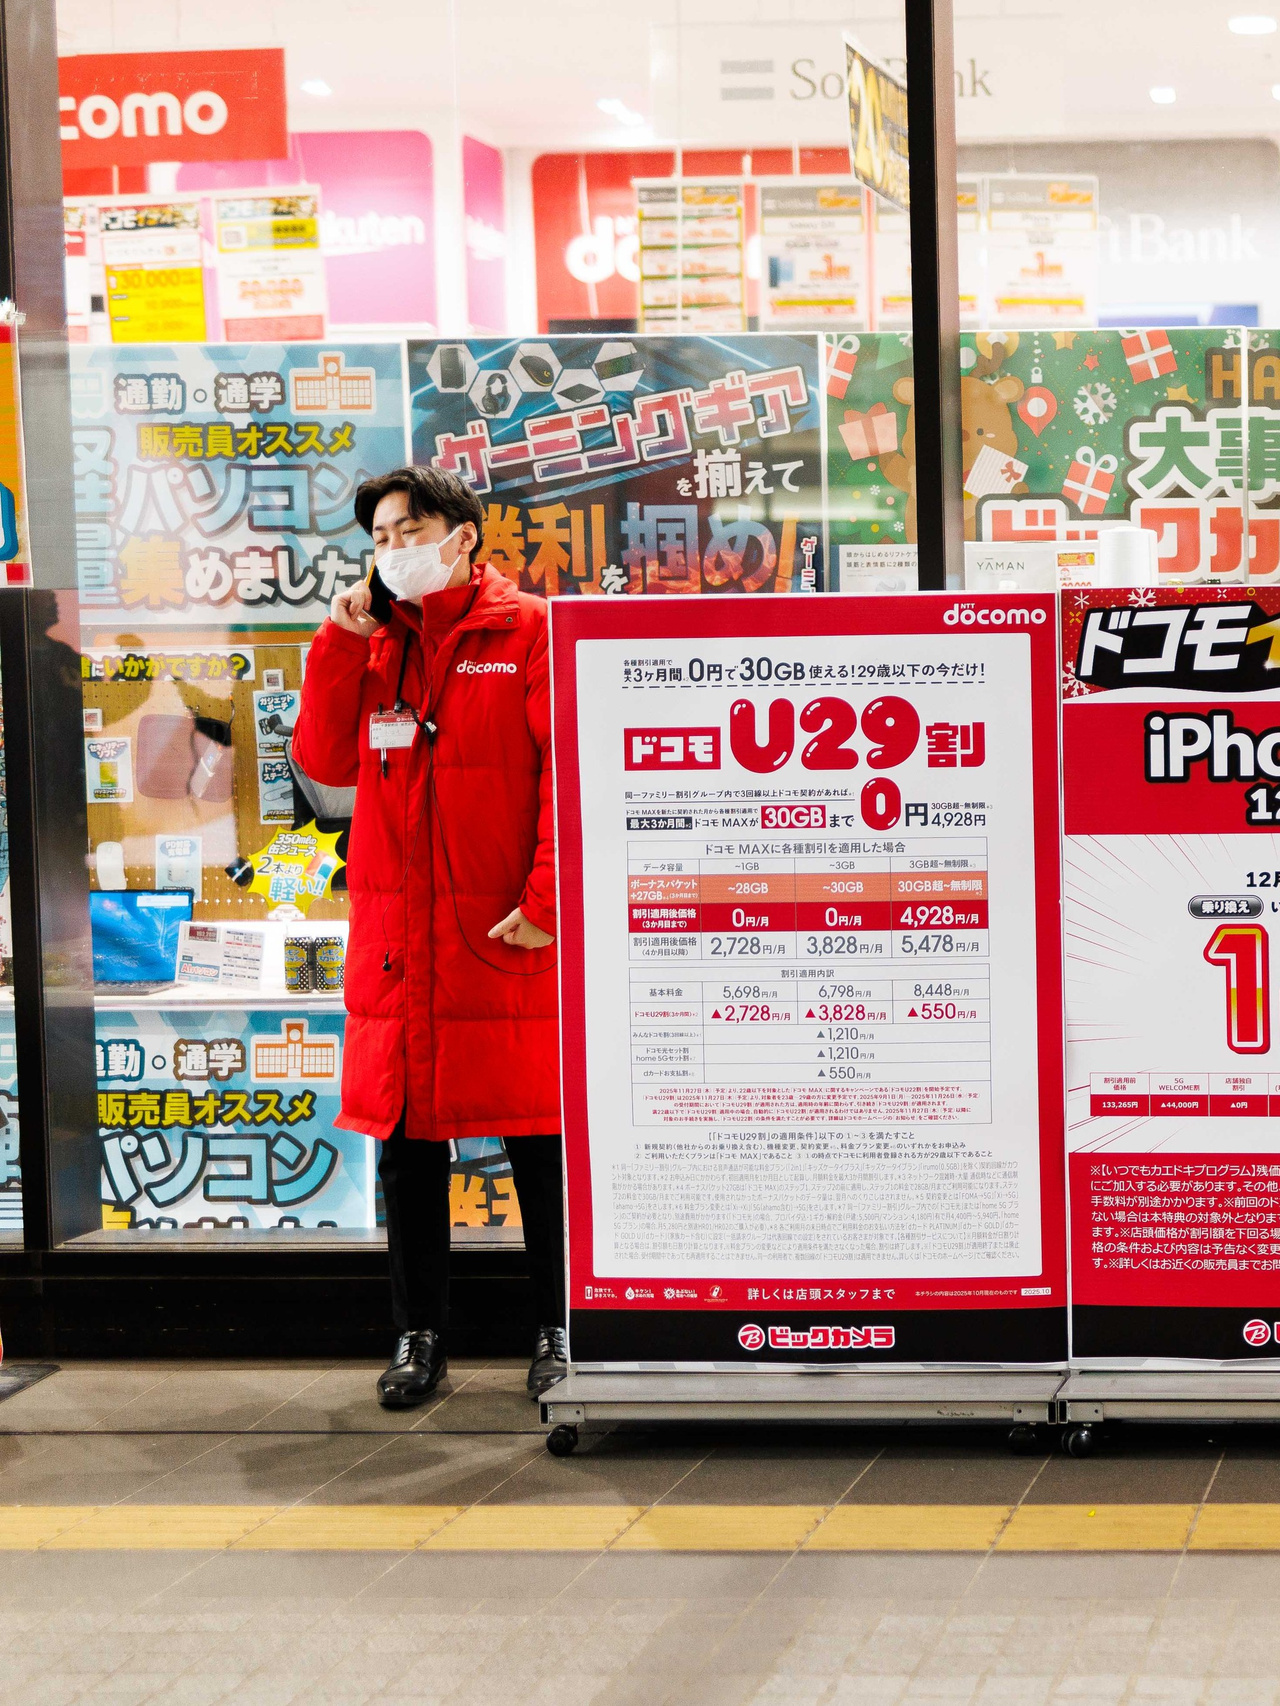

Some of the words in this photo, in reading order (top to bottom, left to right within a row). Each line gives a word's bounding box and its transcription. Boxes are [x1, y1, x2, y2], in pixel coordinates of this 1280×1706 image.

[118, 377, 282, 412] 通勤・通学
[433, 367, 808, 494] ゲーミングギア
[139, 424, 355, 459] 販売員オススメ
[677, 448, 804, 498] を揃えて
[943, 604, 1047, 626] docomo
[456, 660, 517, 674] docomo
[632, 736, 714, 764] ドコモ
[729, 696, 921, 774] U29
[763, 806, 824, 828] 30GB
[931, 811, 986, 829] 4,928円
[268, 844, 317, 857] 缶ジュース
[738, 841, 906, 856] MAXに各種割引を適用した場合
[257, 856, 303, 875] 2本より
[643, 863, 683, 872] データ容量
[630, 879, 698, 889] ボーナスパケット
[632, 908, 697, 919] 割引適用後価格
[633, 937, 697, 947] 割引適用後価格
[781, 969, 835, 978] 割引適用内訳
[649, 988, 683, 997] 基本料金
[1102, 1101, 1139, 1109] 133,265円
[748, 1288, 895, 1301] 詳しくは店頭スタッフまで
[768, 1326, 895, 1349] ビックカメラ
